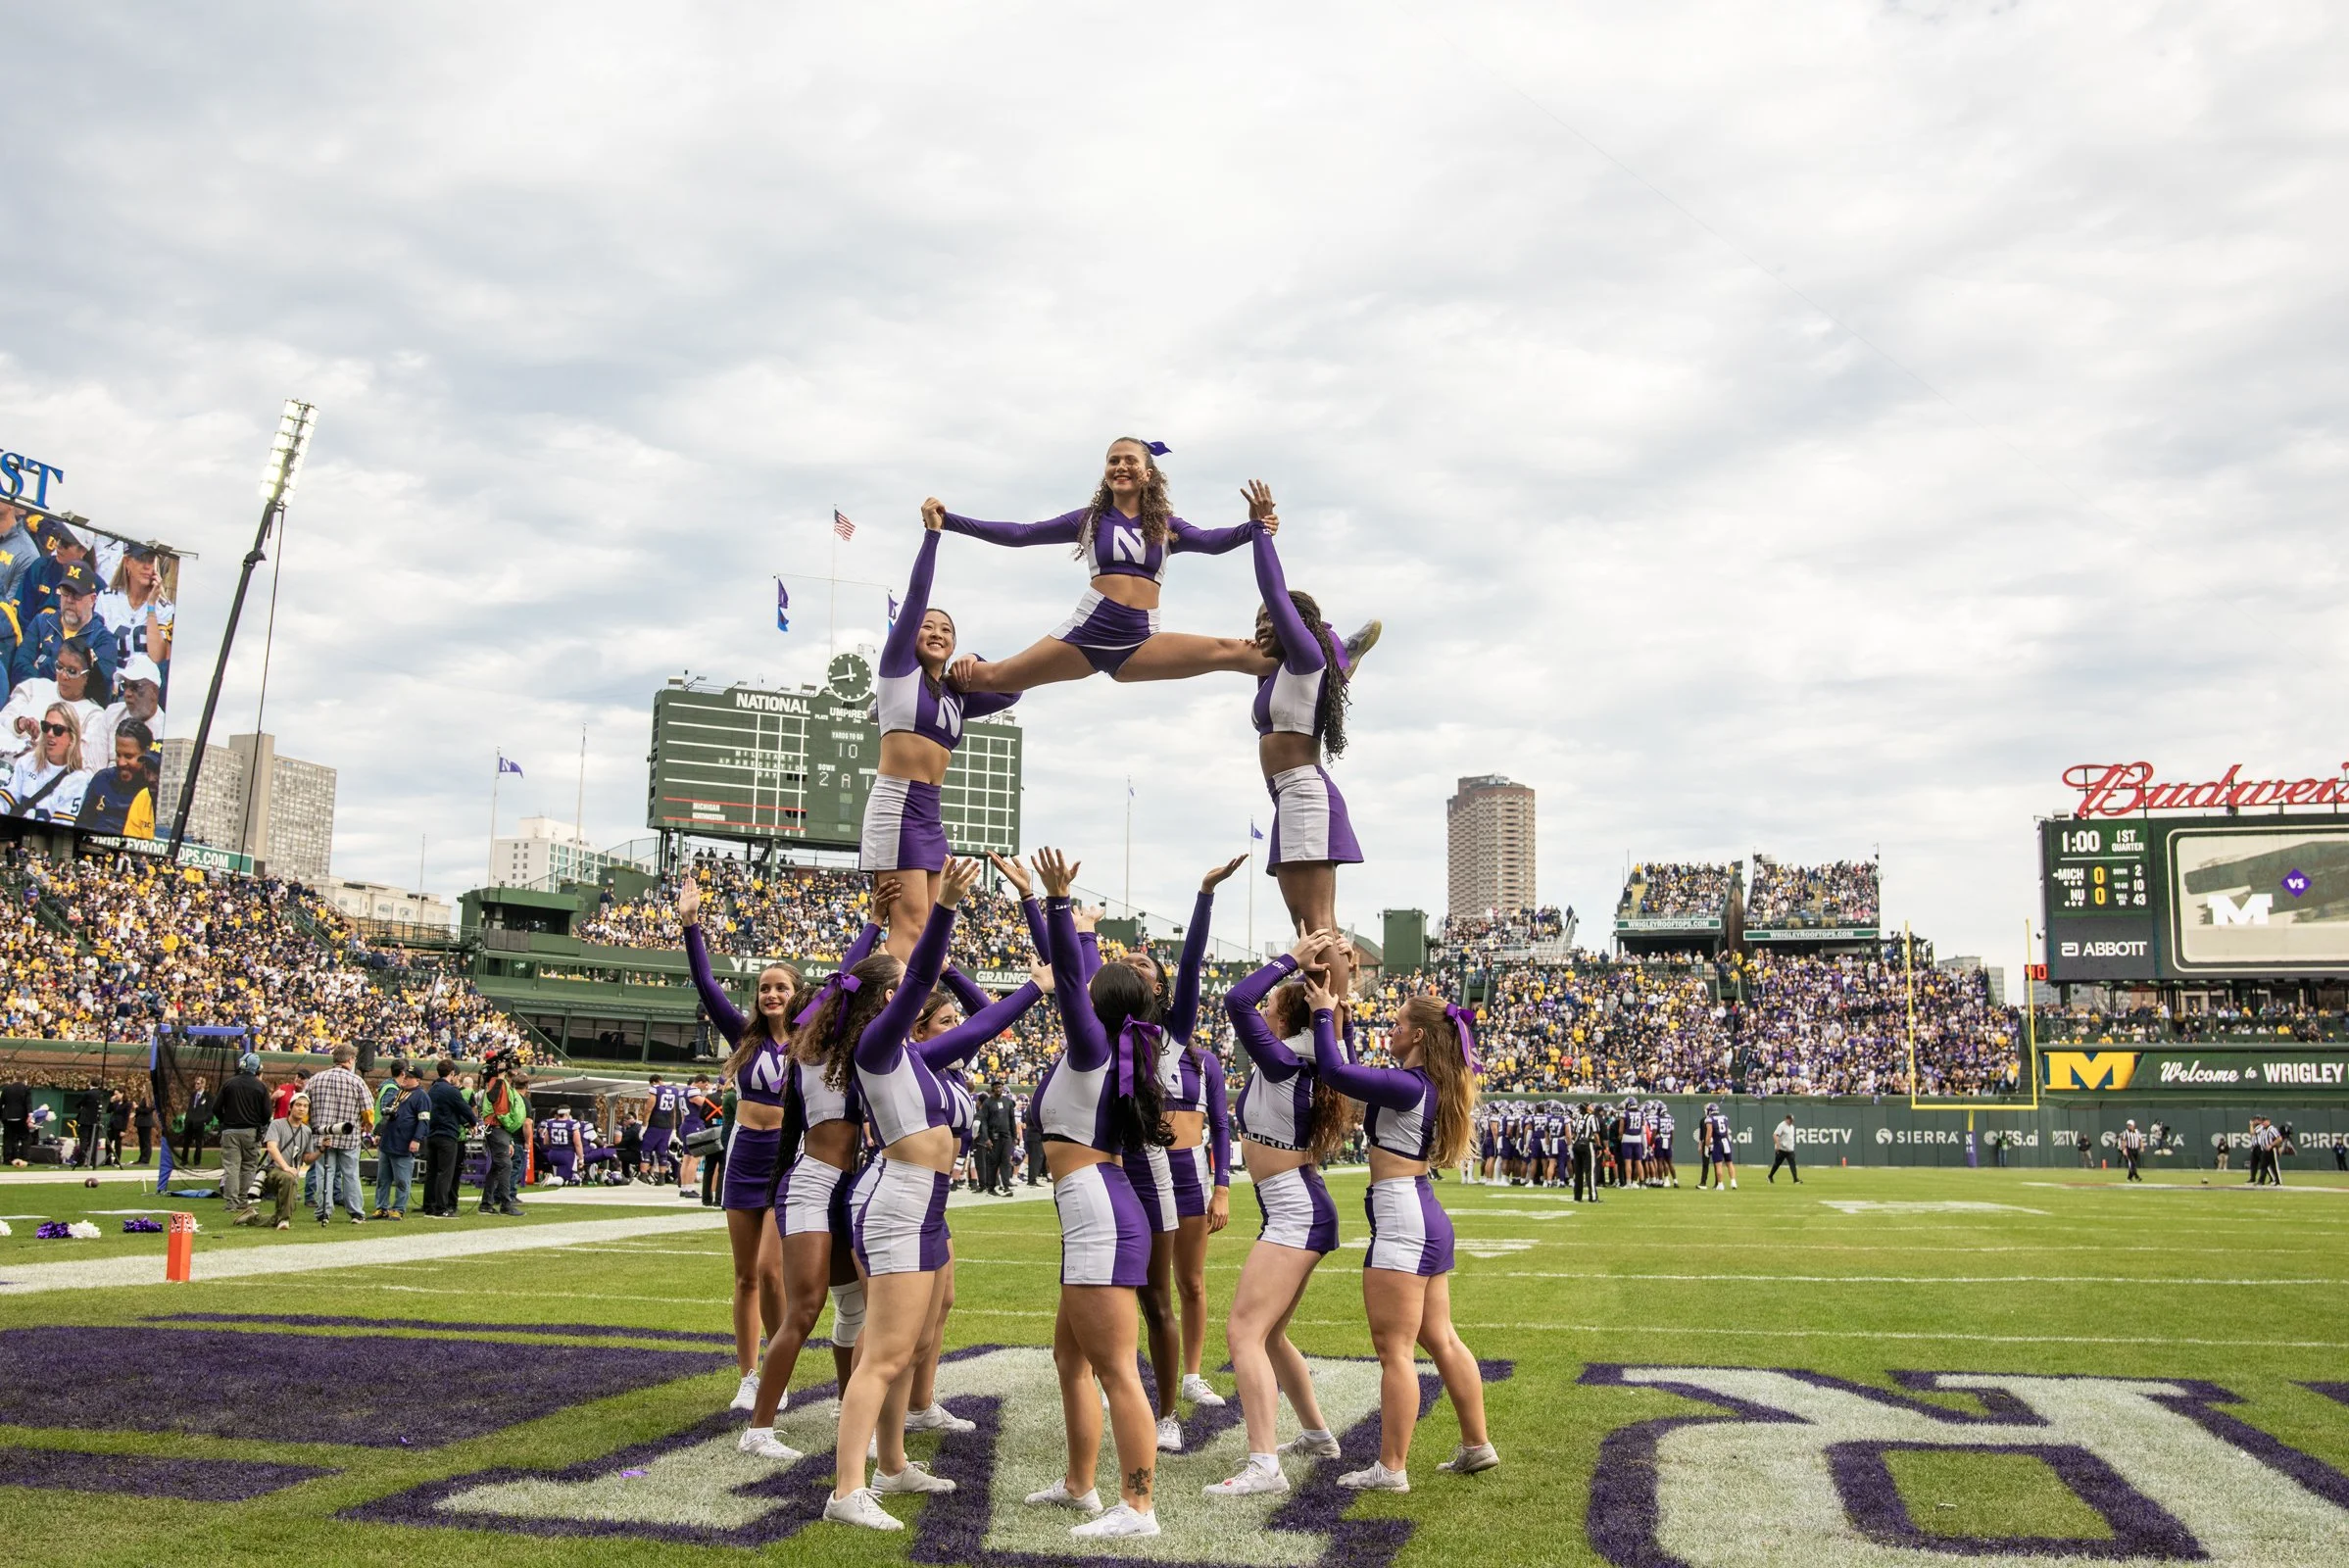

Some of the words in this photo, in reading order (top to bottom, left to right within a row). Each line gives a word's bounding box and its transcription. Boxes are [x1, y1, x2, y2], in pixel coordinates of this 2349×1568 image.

[1113, 525, 1147, 565] N
[67, 564, 82, 579] M
[736, 692, 811, 715] NATIONAL
[829, 707, 868, 720] UMPIRES
[936, 694, 964, 739] N
[735, 750, 793, 761] MILITARY
[839, 742, 858, 759] 10
[758, 771, 777, 780] DAY
[819, 771, 829, 787] 2
[2062, 830, 2101, 854] 1:00
[2116, 829, 2136, 843] 1ST
[2111, 841, 2144, 853] QUARTER
[2058, 867, 2084, 881] MICH
[2093, 865, 2106, 885] 0
[2134, 863, 2143, 877] 2
[2133, 878, 2145, 892] 10
[2286, 878, 2305, 890] VS
[2070, 888, 2085, 901] NU
[2094, 886, 2107, 906] 0
[2132, 893, 2146, 906] 43
[2207, 893, 2274, 925] M
[1627, 919, 1710, 929] WRIGLEYROOFTOPS.COM
[1769, 931, 1855, 940] WRIGLEYROOFTOPS.COM
[2082, 941, 2148, 957] ABBOTT
[751, 1051, 784, 1094] N
[2044, 1052, 2142, 1091] M
[2160, 1059, 2239, 1084] Welcome
[2245, 1065, 2258, 1080] to
[2263, 1061, 2344, 1084] WRIGLEY
[659, 1093, 675, 1111] 63
[551, 1127, 569, 1146] 50
[1795, 1128, 1854, 1145] RECTV
[1896, 1131, 1959, 1145] SIERRA
[2227, 1132, 2253, 1149] IFS
